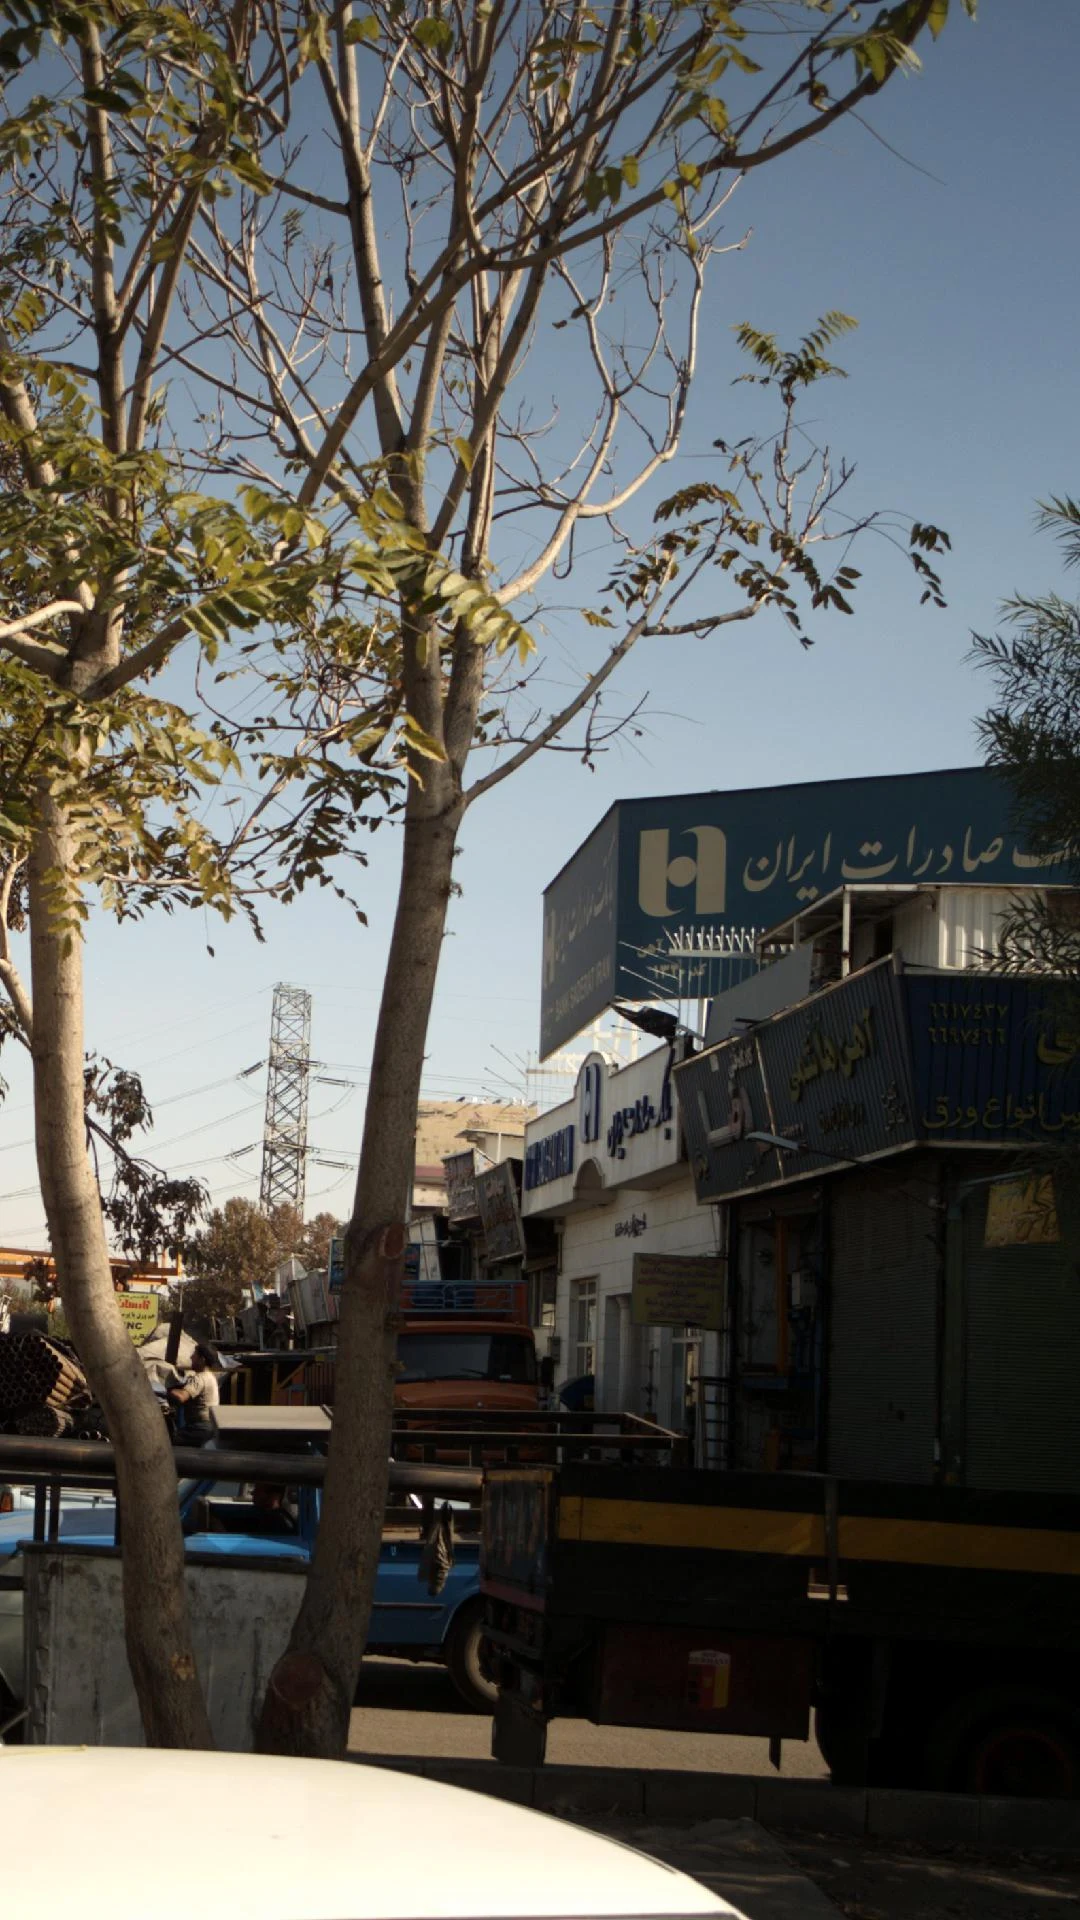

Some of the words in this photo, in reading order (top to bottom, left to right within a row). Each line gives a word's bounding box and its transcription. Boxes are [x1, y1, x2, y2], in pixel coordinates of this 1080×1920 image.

[741, 831, 832, 902] ایران
[839, 823, 1005, 880] صادرات
[921, 1095, 979, 1129] ورق
